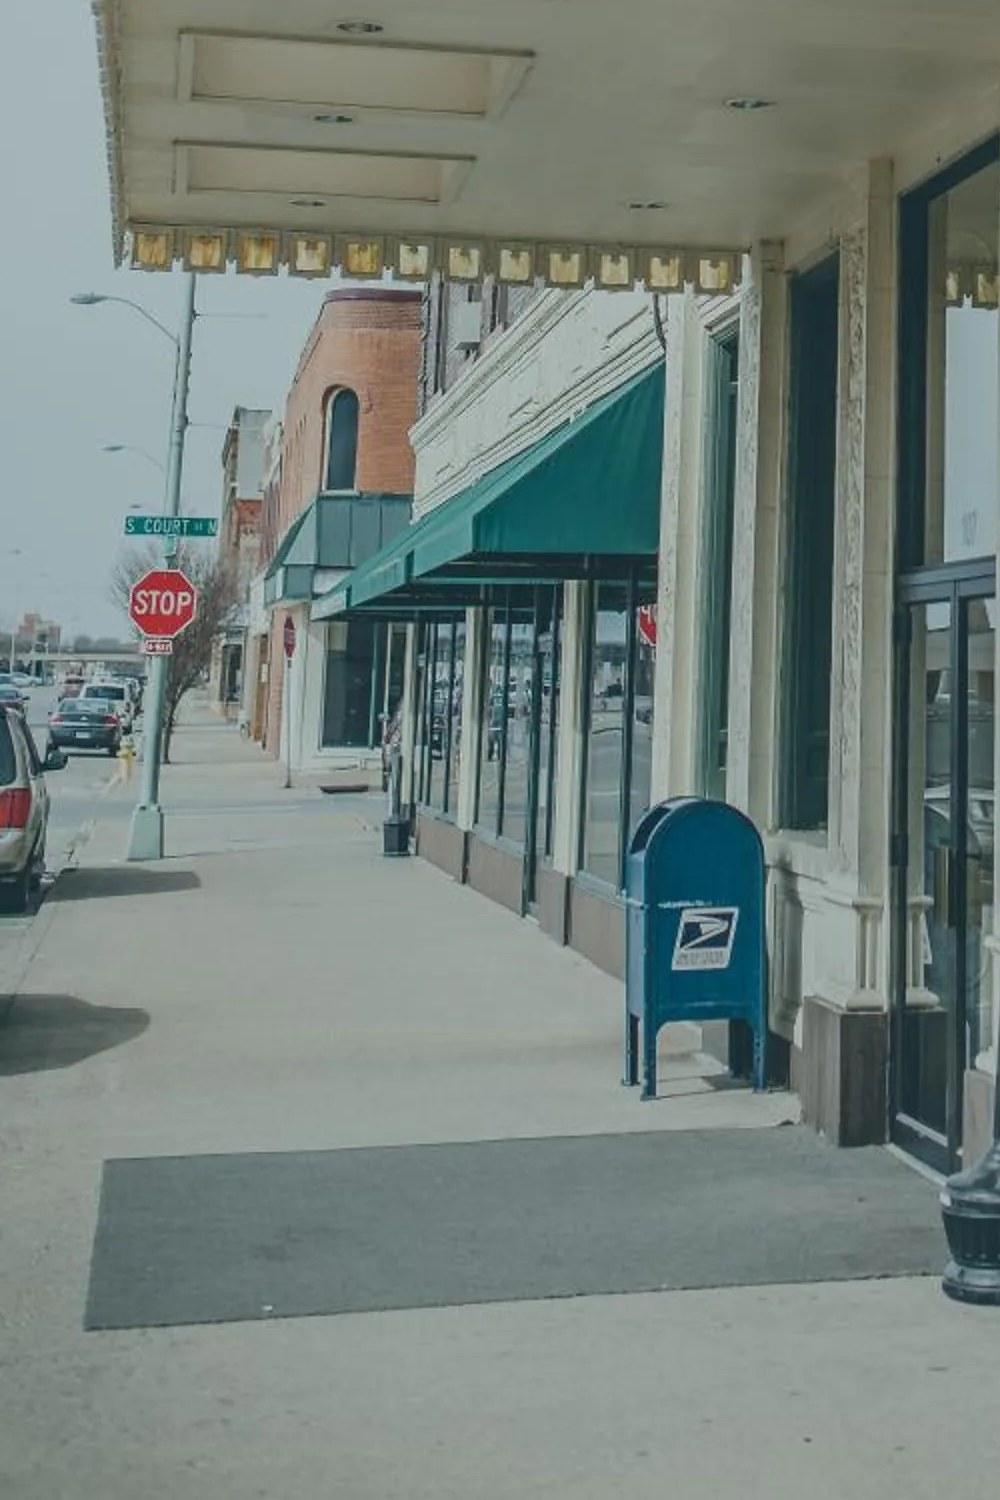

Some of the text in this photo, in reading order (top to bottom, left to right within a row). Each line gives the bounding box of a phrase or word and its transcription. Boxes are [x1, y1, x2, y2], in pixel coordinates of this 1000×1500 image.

[127, 516, 136, 533] S
[143, 518, 191, 534] COURT
[207, 519, 217, 535] N
[134, 589, 192, 616] STOP
